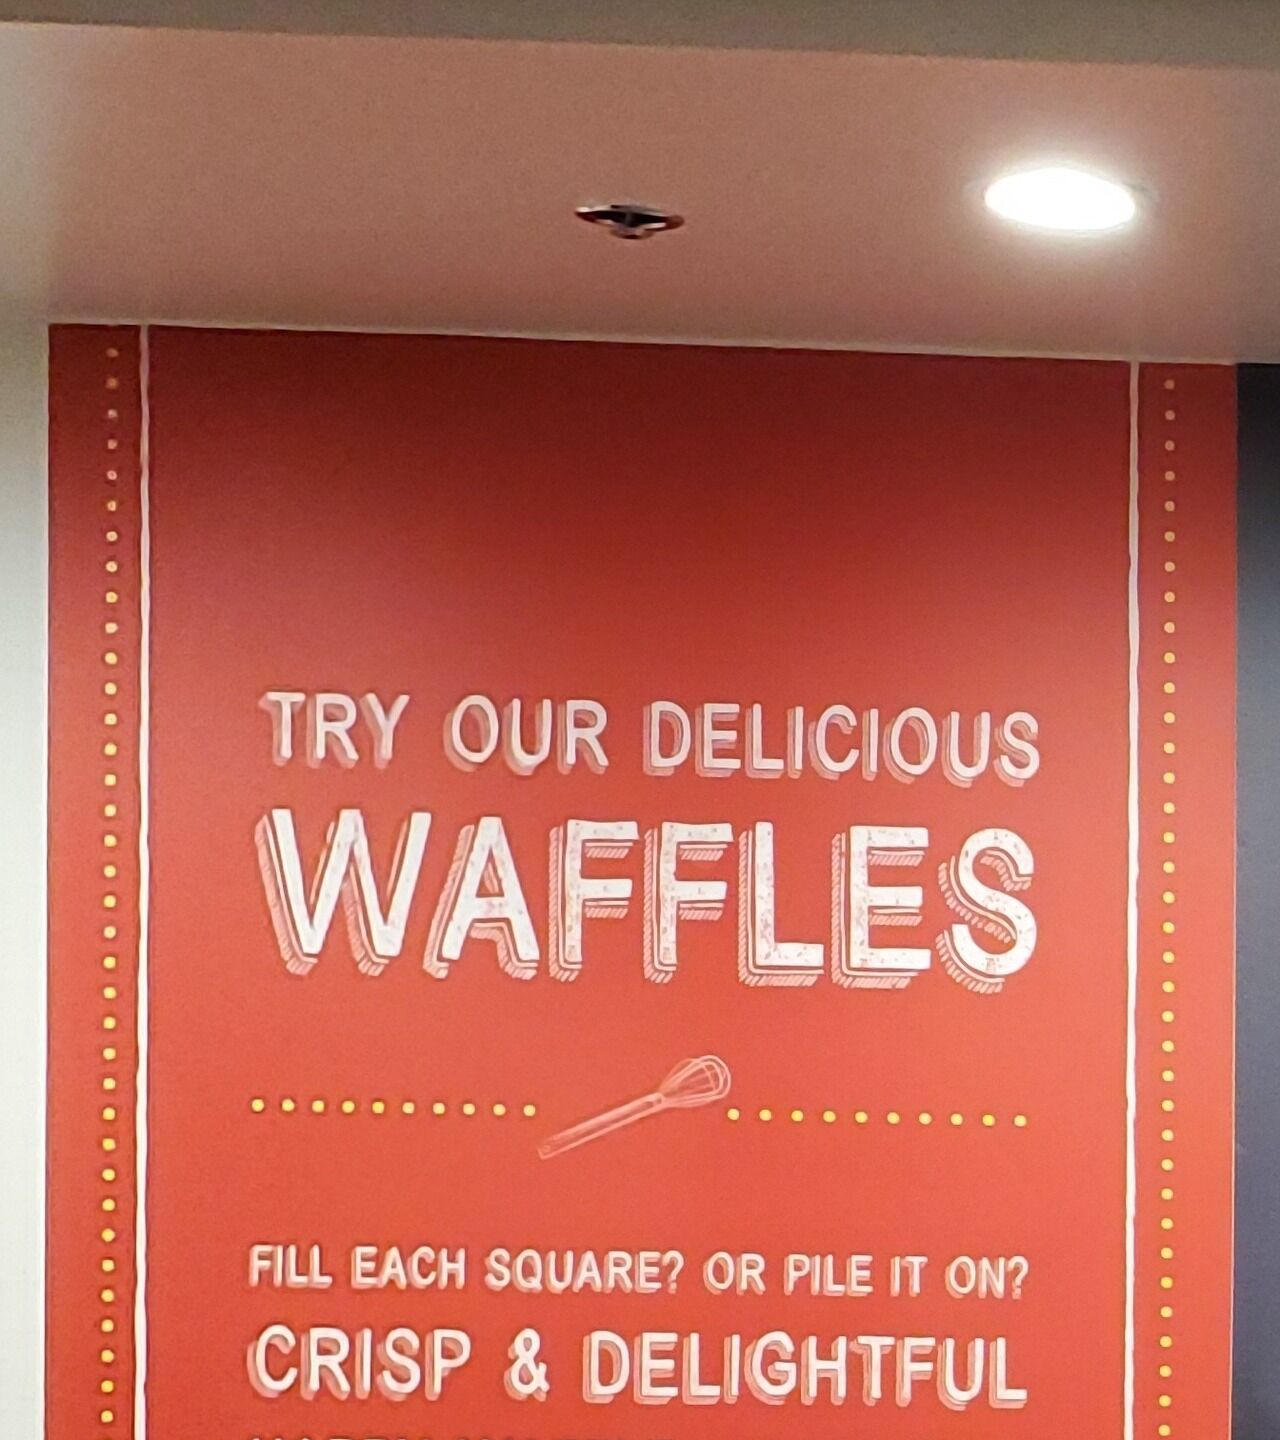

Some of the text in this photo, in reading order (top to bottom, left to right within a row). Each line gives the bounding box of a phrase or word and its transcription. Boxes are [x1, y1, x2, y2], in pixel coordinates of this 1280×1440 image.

[262, 691, 1041, 788] TRY OUR DELICIOUS
[255, 807, 1037, 994] WAFFLES
[248, 1244, 1030, 1299] FILL EACH SQUARE? OR PILE IT ON?
[246, 1324, 1028, 1411] CRISP & DELIGHTFUL
